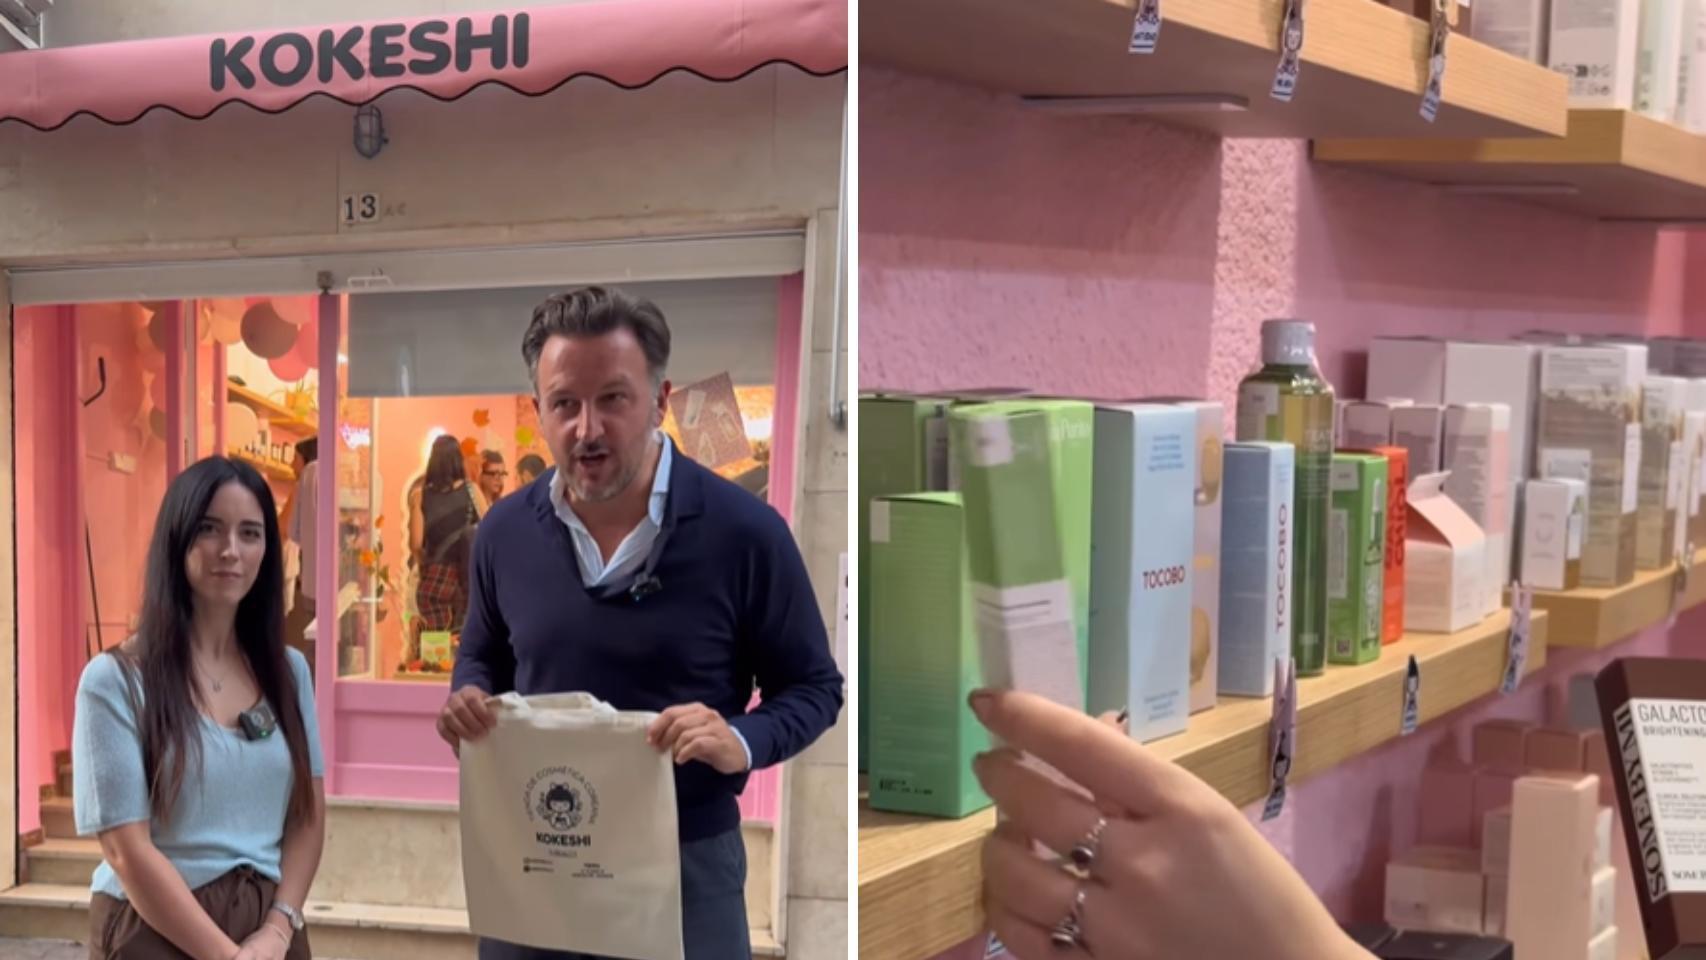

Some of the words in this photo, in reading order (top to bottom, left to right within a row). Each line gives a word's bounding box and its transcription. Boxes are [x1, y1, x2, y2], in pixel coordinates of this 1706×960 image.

[210, 13, 529, 91] KOKESHI
[344, 194, 376, 220] 13
[1143, 565, 1186, 590] TOCOBO
[1275, 504, 1288, 633] TOCOBO
[1616, 707, 1636, 752] MI
[1626, 757, 1646, 797] BY
[536, 832, 591, 846] KOKESHI
[1635, 799, 1667, 898] SOME
